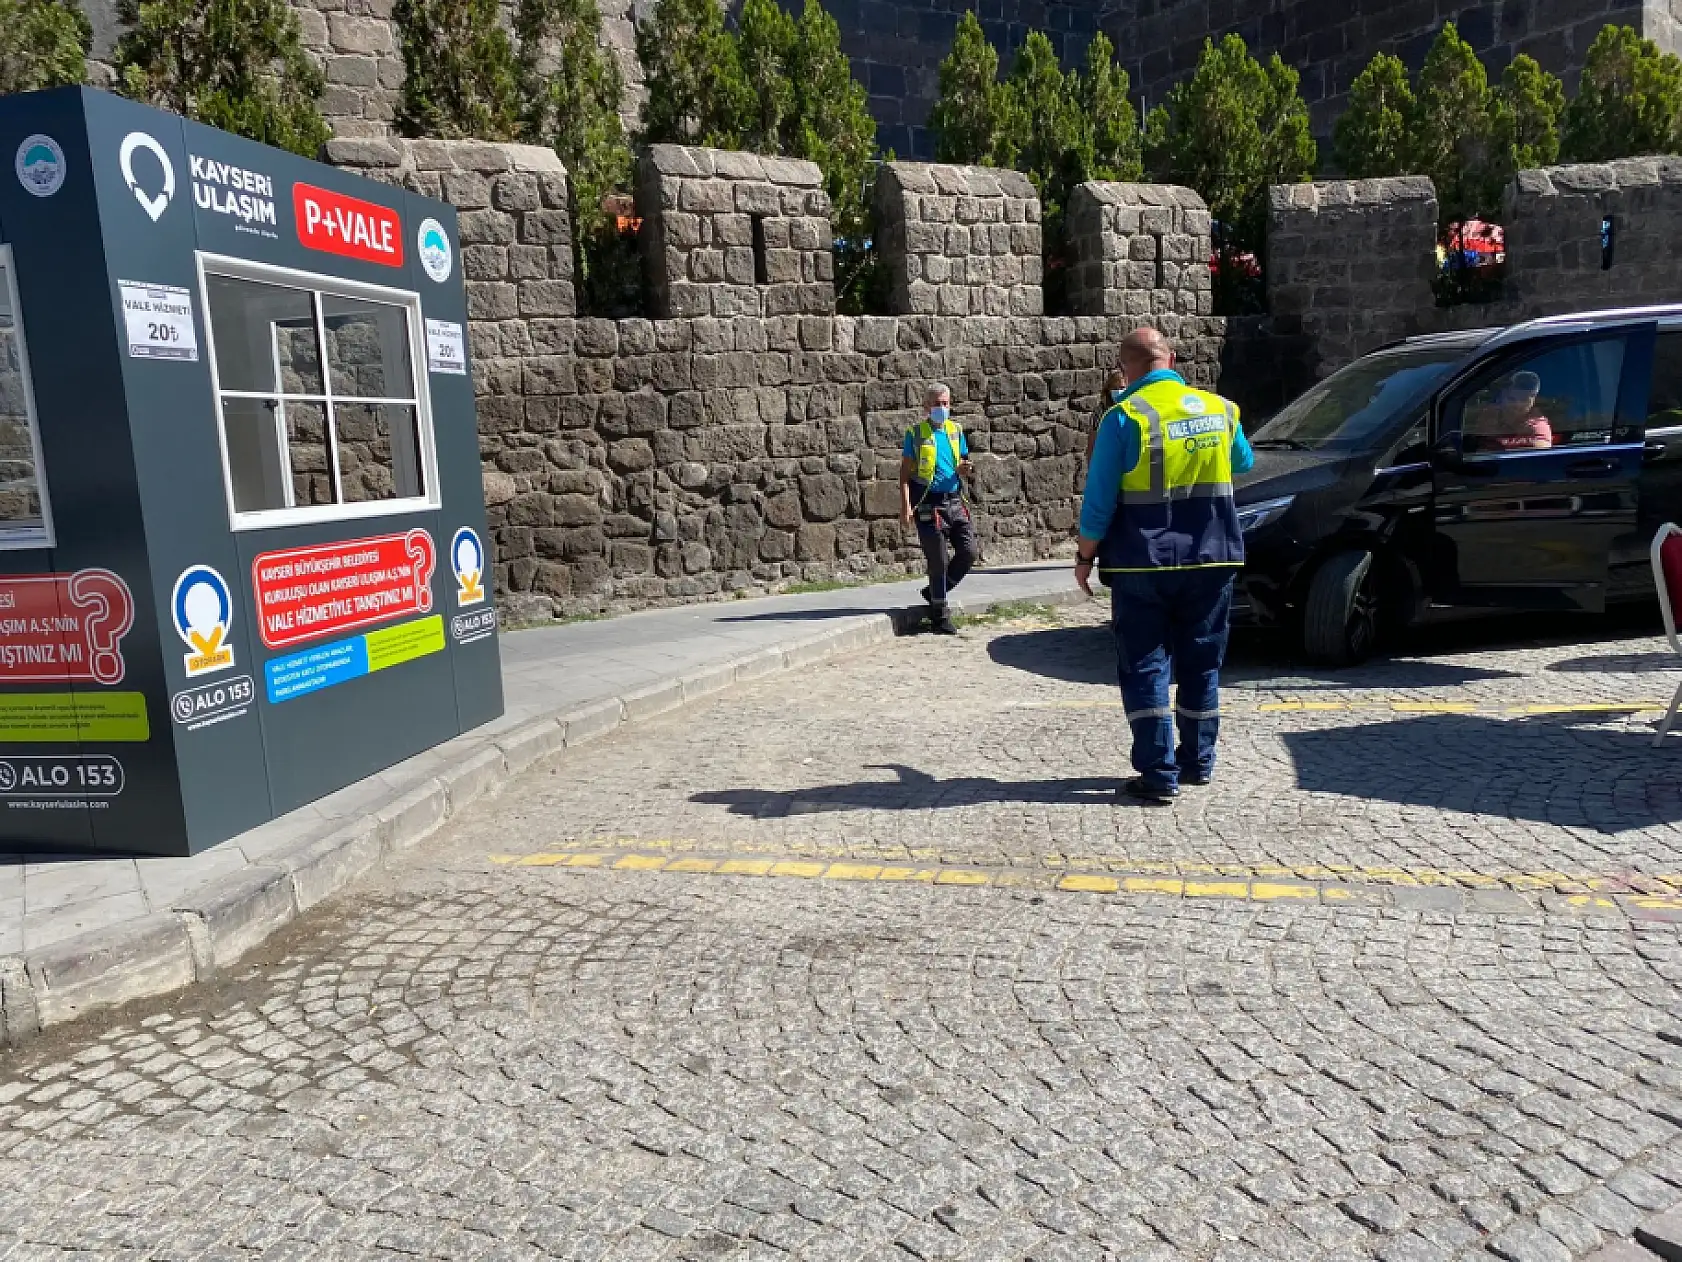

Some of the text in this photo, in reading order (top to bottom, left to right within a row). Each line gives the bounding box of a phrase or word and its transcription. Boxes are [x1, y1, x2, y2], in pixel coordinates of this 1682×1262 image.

[190, 154, 273, 198] KAYSERİ
[193, 181, 277, 225] ULAŞIM
[304, 199, 395, 253] P+VALE
[125, 300, 151, 311] VALE
[1168, 421, 1190, 438] VALE
[261, 561, 293, 582] KAYSERİ
[295, 554, 341, 576] BÜYÜKŞEHİR
[264, 587, 308, 606] KURULUŞU
[309, 581, 330, 596] OLAN
[267, 611, 294, 633] VALE
[296, 597, 352, 626] HİZMETİYLE
[353, 587, 401, 612] TANIŞTINIZ
[60, 643, 82, 663] MI
[197, 681, 250, 711] ALO 153
[21, 765, 115, 786] ALO 153
